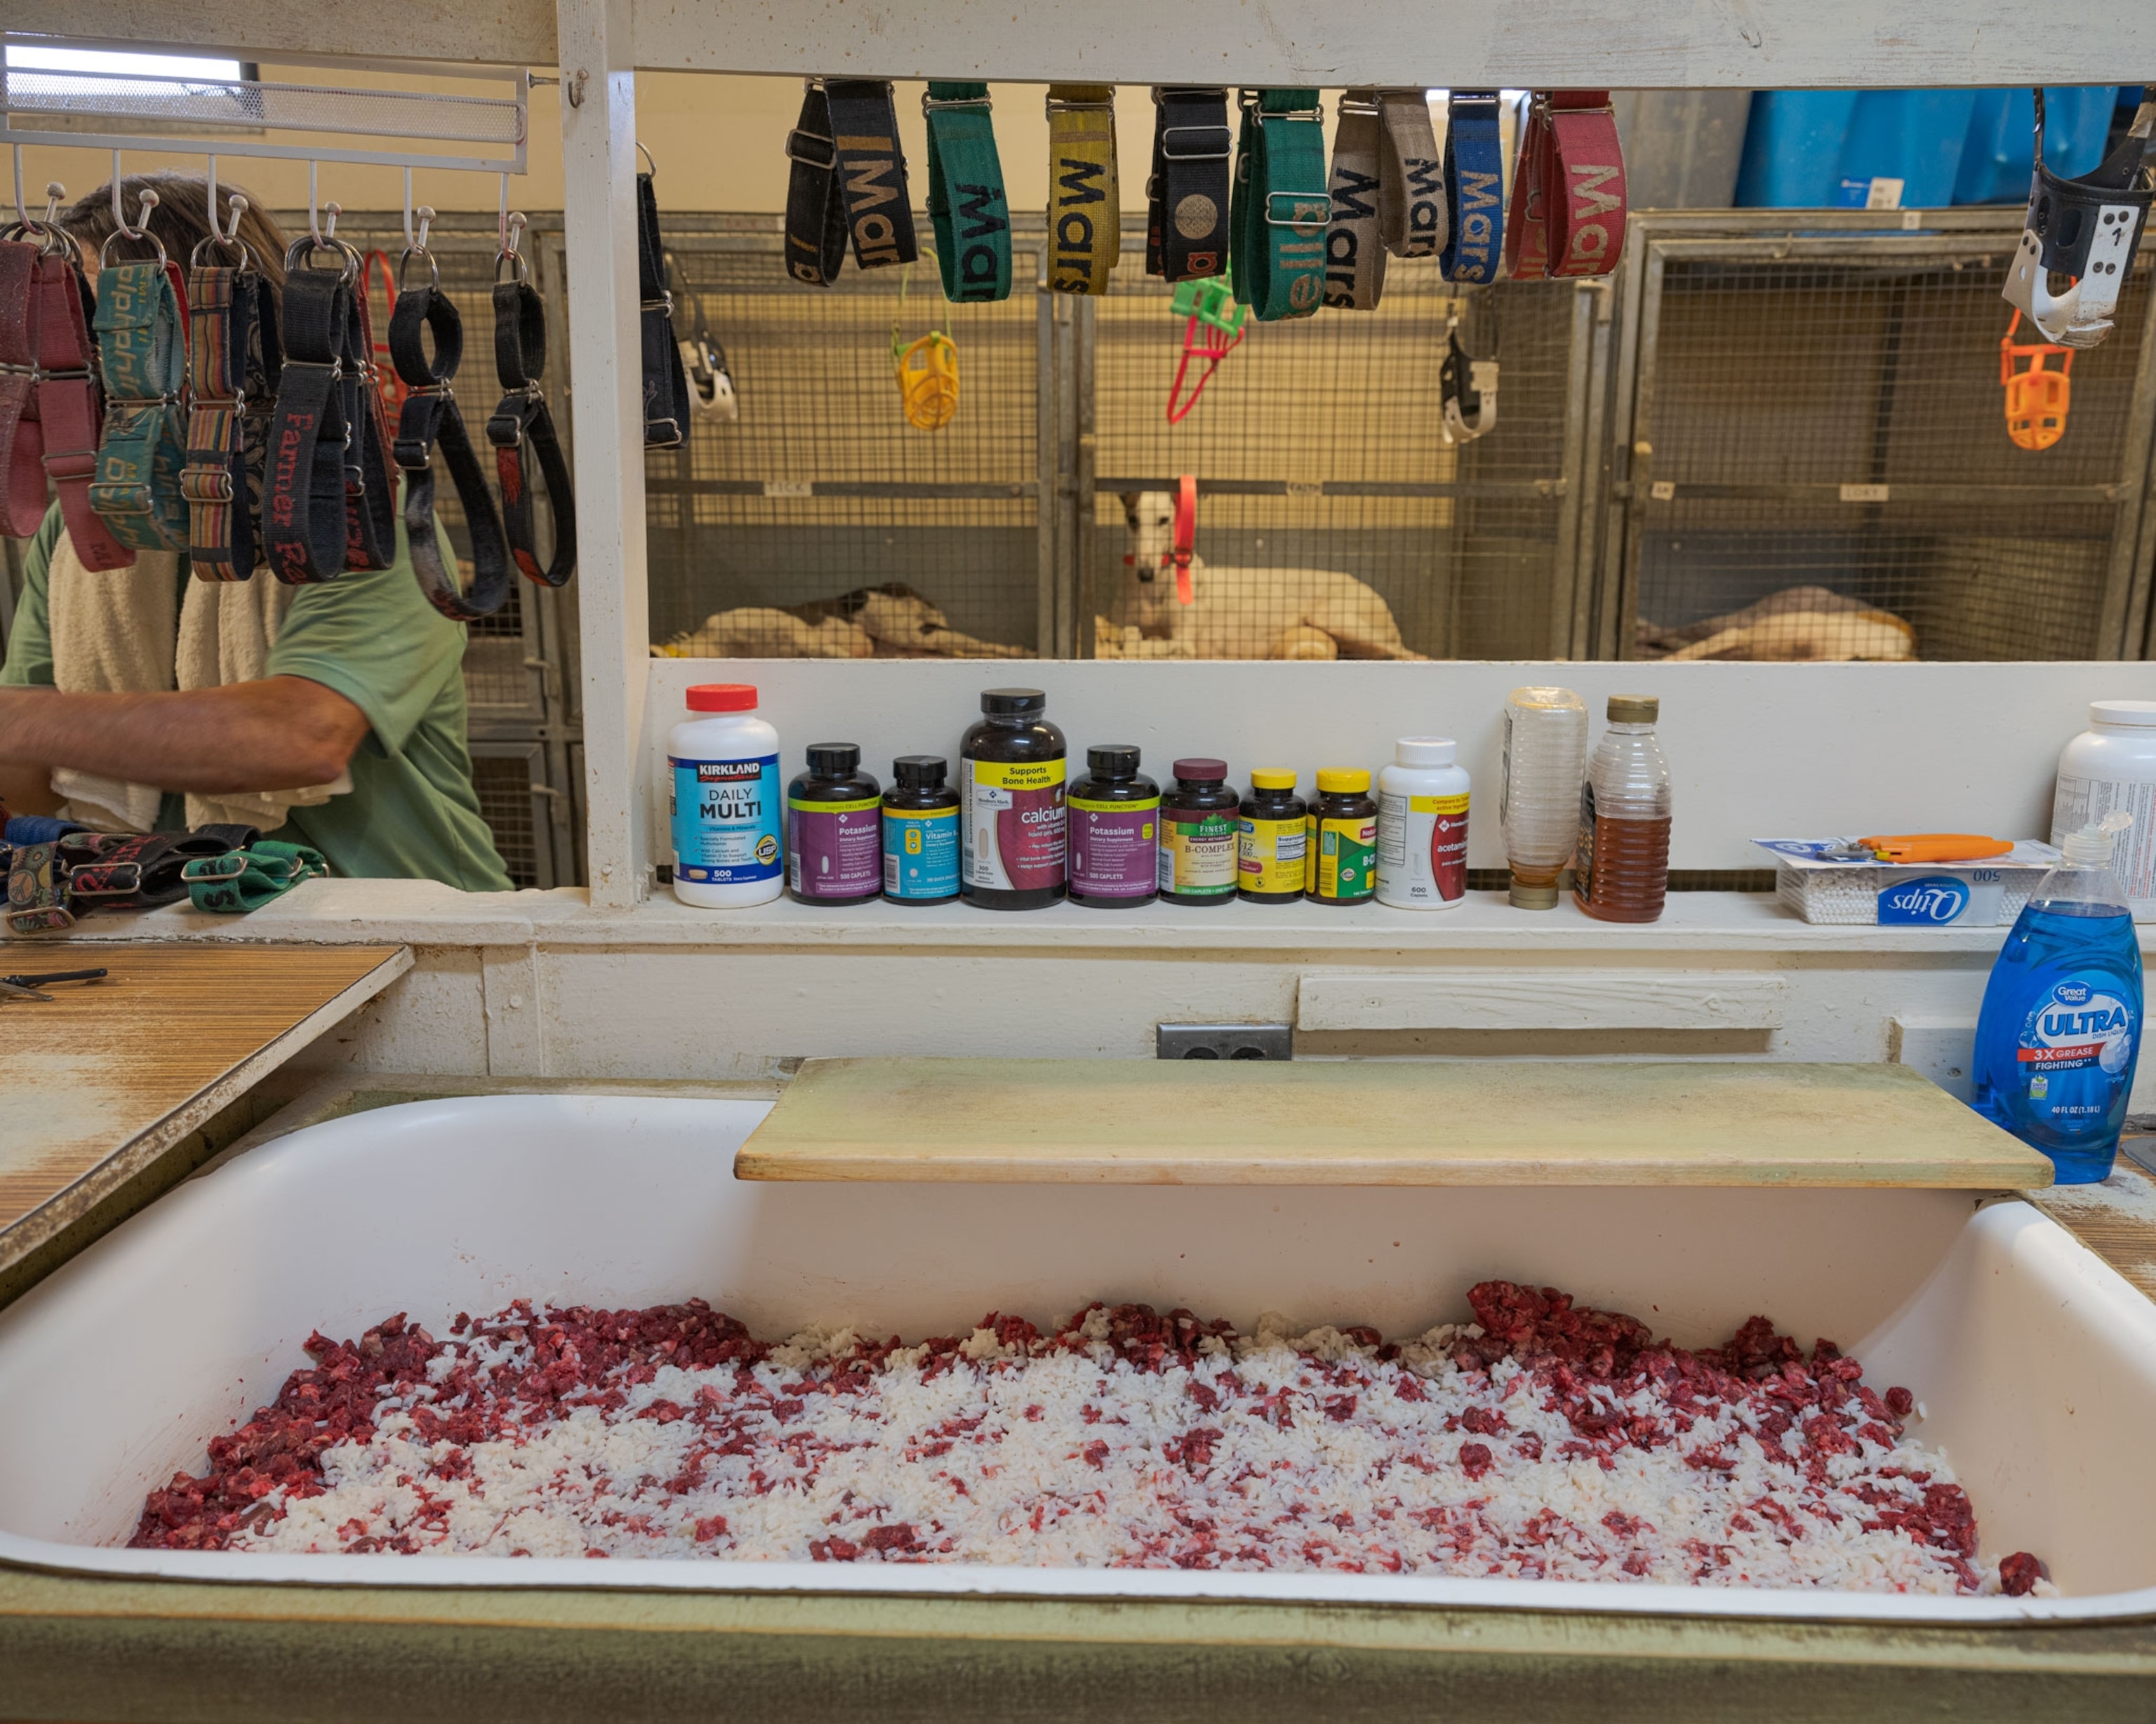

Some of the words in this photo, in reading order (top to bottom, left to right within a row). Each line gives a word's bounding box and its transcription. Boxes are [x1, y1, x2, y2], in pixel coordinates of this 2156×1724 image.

[843, 161, 899, 268] Mar
[1055, 159, 1106, 295] Mars
[1455, 171, 1500, 279] Mars
[273, 413, 314, 526] Farmer
[699, 763, 760, 775] KIRKLAND
[1009, 767, 1046, 776] Supports
[709, 789, 752, 801] DAILY
[700, 801, 761, 819] MULTI
[1021, 806, 1065, 824] calcium
[839, 824, 877, 836] Potassium
[1089, 827, 1134, 836] Potassium
[1199, 824, 1227, 833] FINEST
[926, 831, 952, 840] Vitamin
[757, 843, 777, 857] USP
[1185, 843, 1235, 853] B-COMPLEX
[1974, 869, 2001, 882] 500
[2058, 987, 2087, 996] Great
[2044, 1007, 2126, 1036] ULTRA
[2108, 1028, 2126, 1036] LIQUID
[2034, 1050, 2054, 1060] 3X
[2056, 1047, 2093, 1058] GREASE
[2105, 1074, 2125, 1083] original
